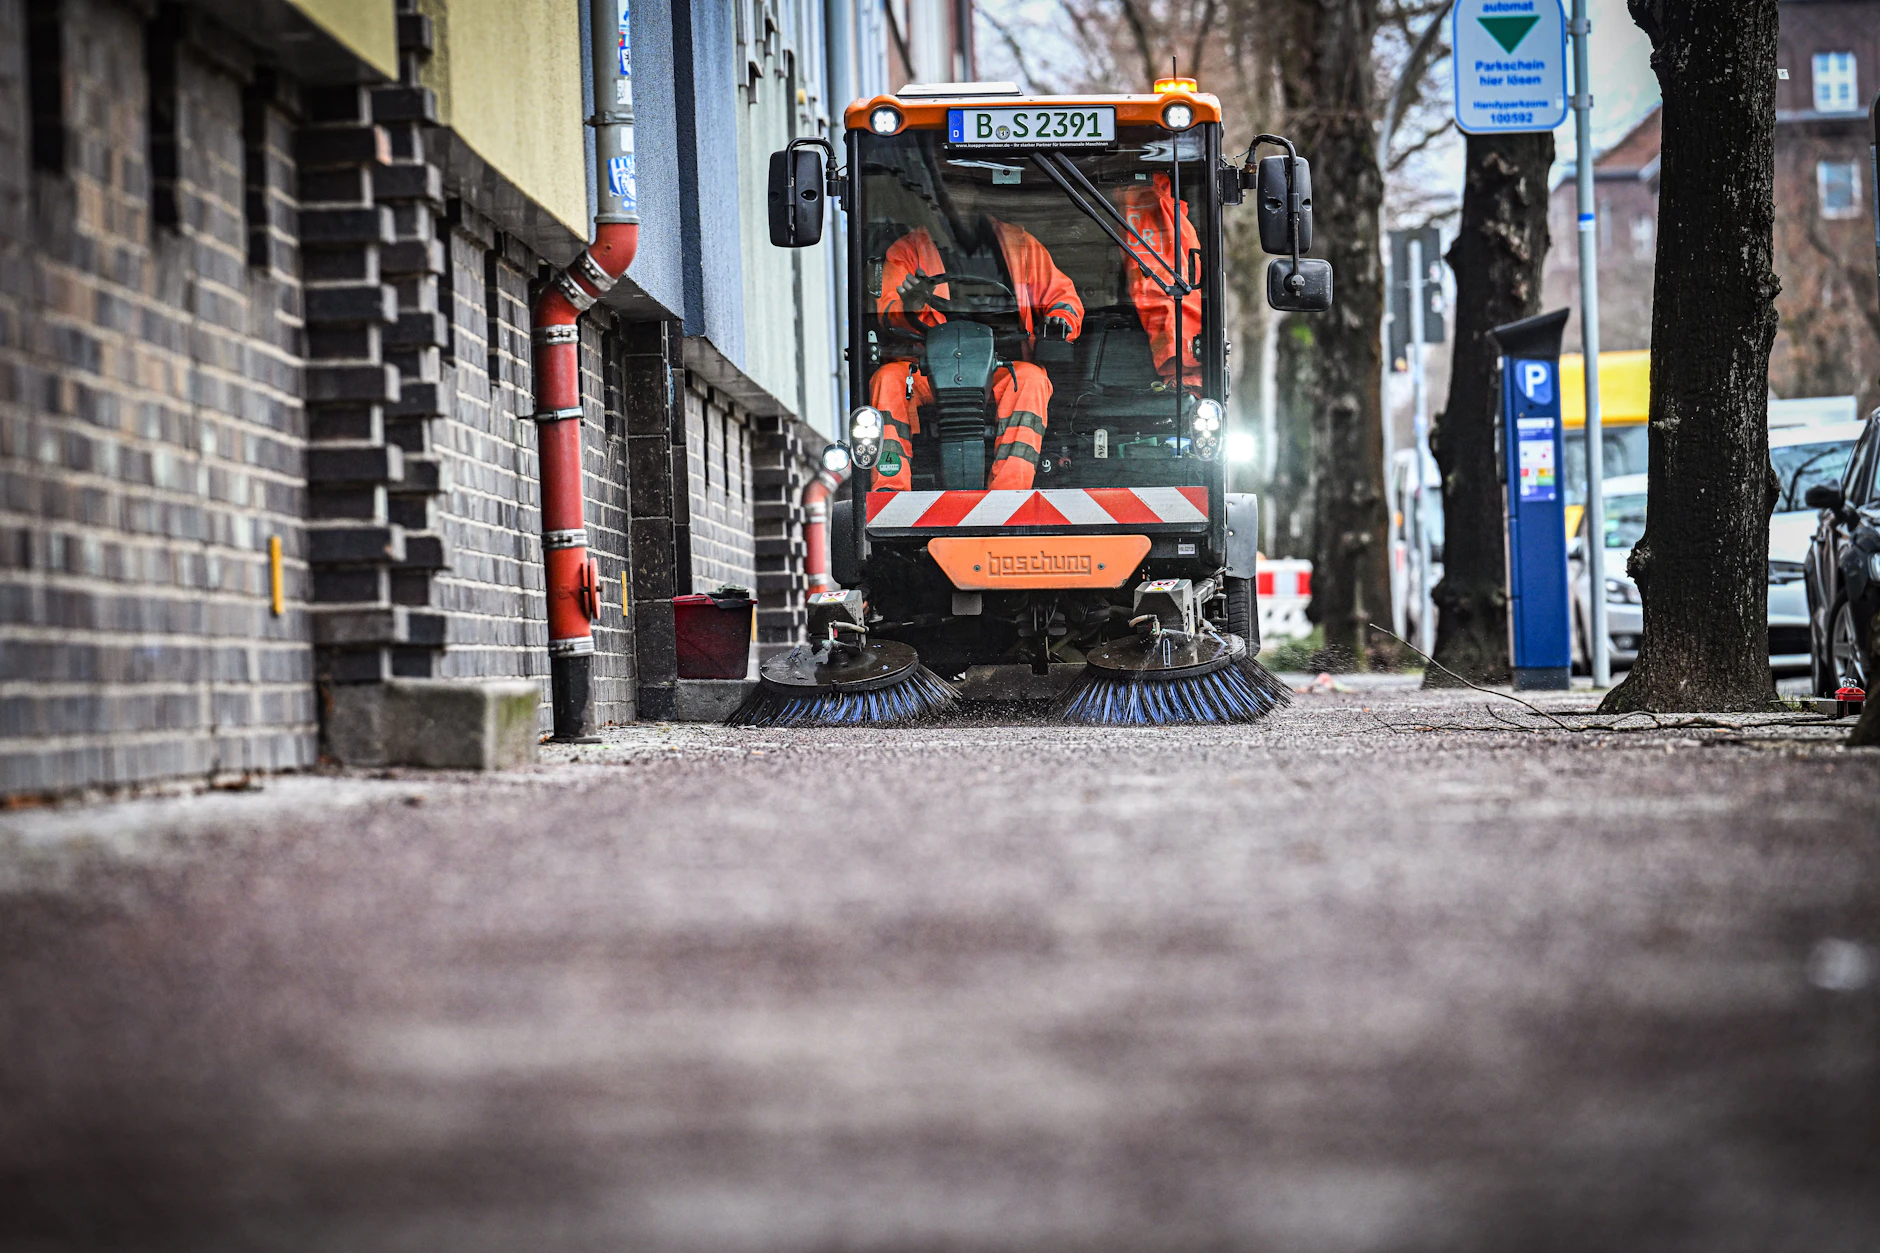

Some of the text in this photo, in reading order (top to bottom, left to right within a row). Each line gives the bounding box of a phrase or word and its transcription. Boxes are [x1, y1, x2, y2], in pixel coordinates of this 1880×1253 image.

[1482, 1, 1534, 12] automat
[1475, 60, 1545, 72] Parkschein
[1479, 75, 1542, 86] hier lösen
[1473, 100, 1549, 109] Handyparkzone
[976, 112, 1102, 138] B S 2391
[953, 129, 960, 138] D
[1525, 363, 1548, 398] P
[885, 451, 893, 465] 4
[988, 550, 1092, 576] boschung
